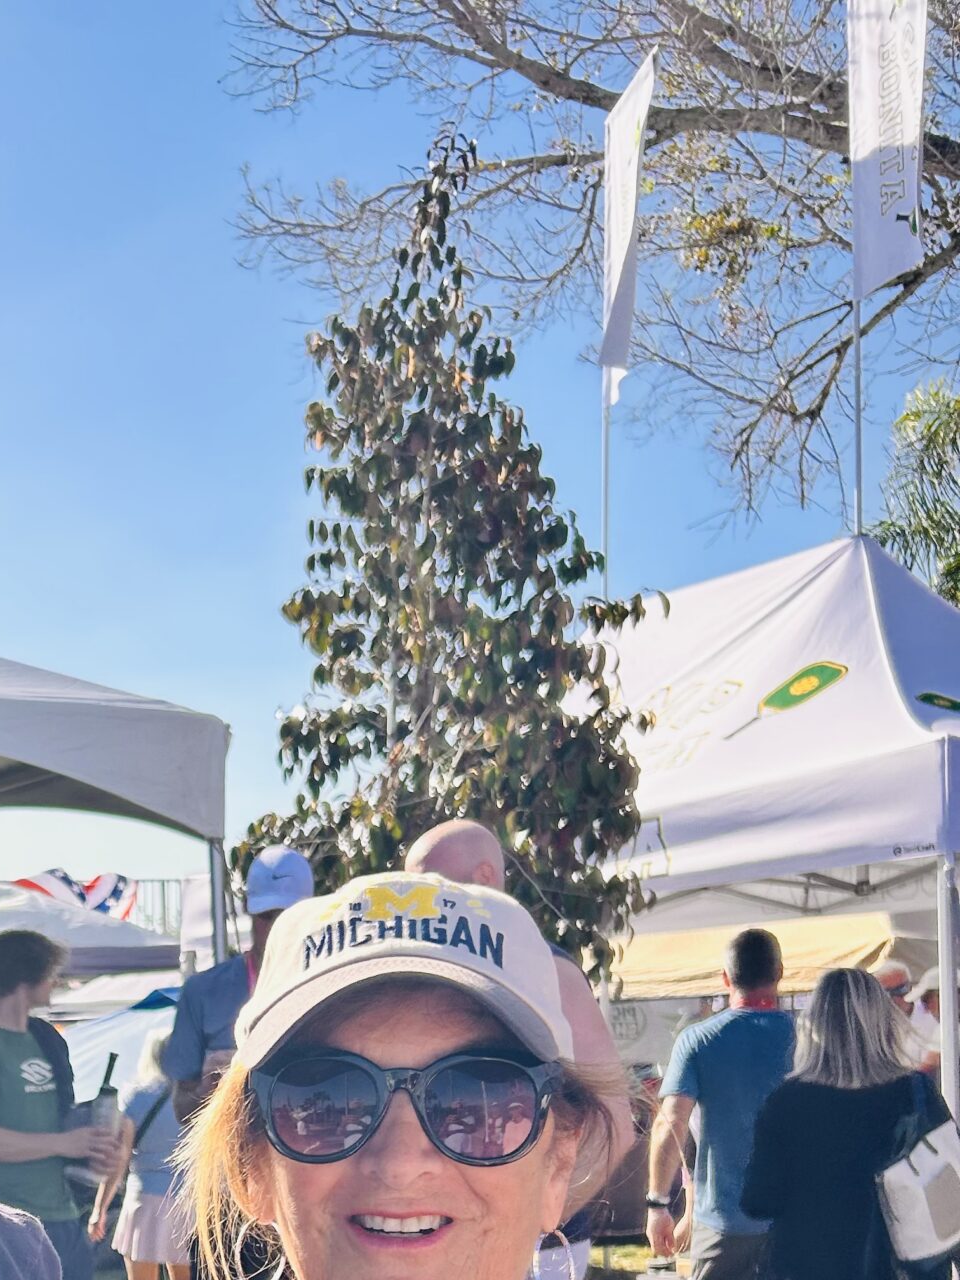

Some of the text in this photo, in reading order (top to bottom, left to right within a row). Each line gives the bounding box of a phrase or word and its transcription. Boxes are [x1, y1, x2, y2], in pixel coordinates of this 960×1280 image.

[879, 36, 906, 216] BONITA
[365, 886, 440, 919] M
[303, 915, 505, 970] MICHIGAN
